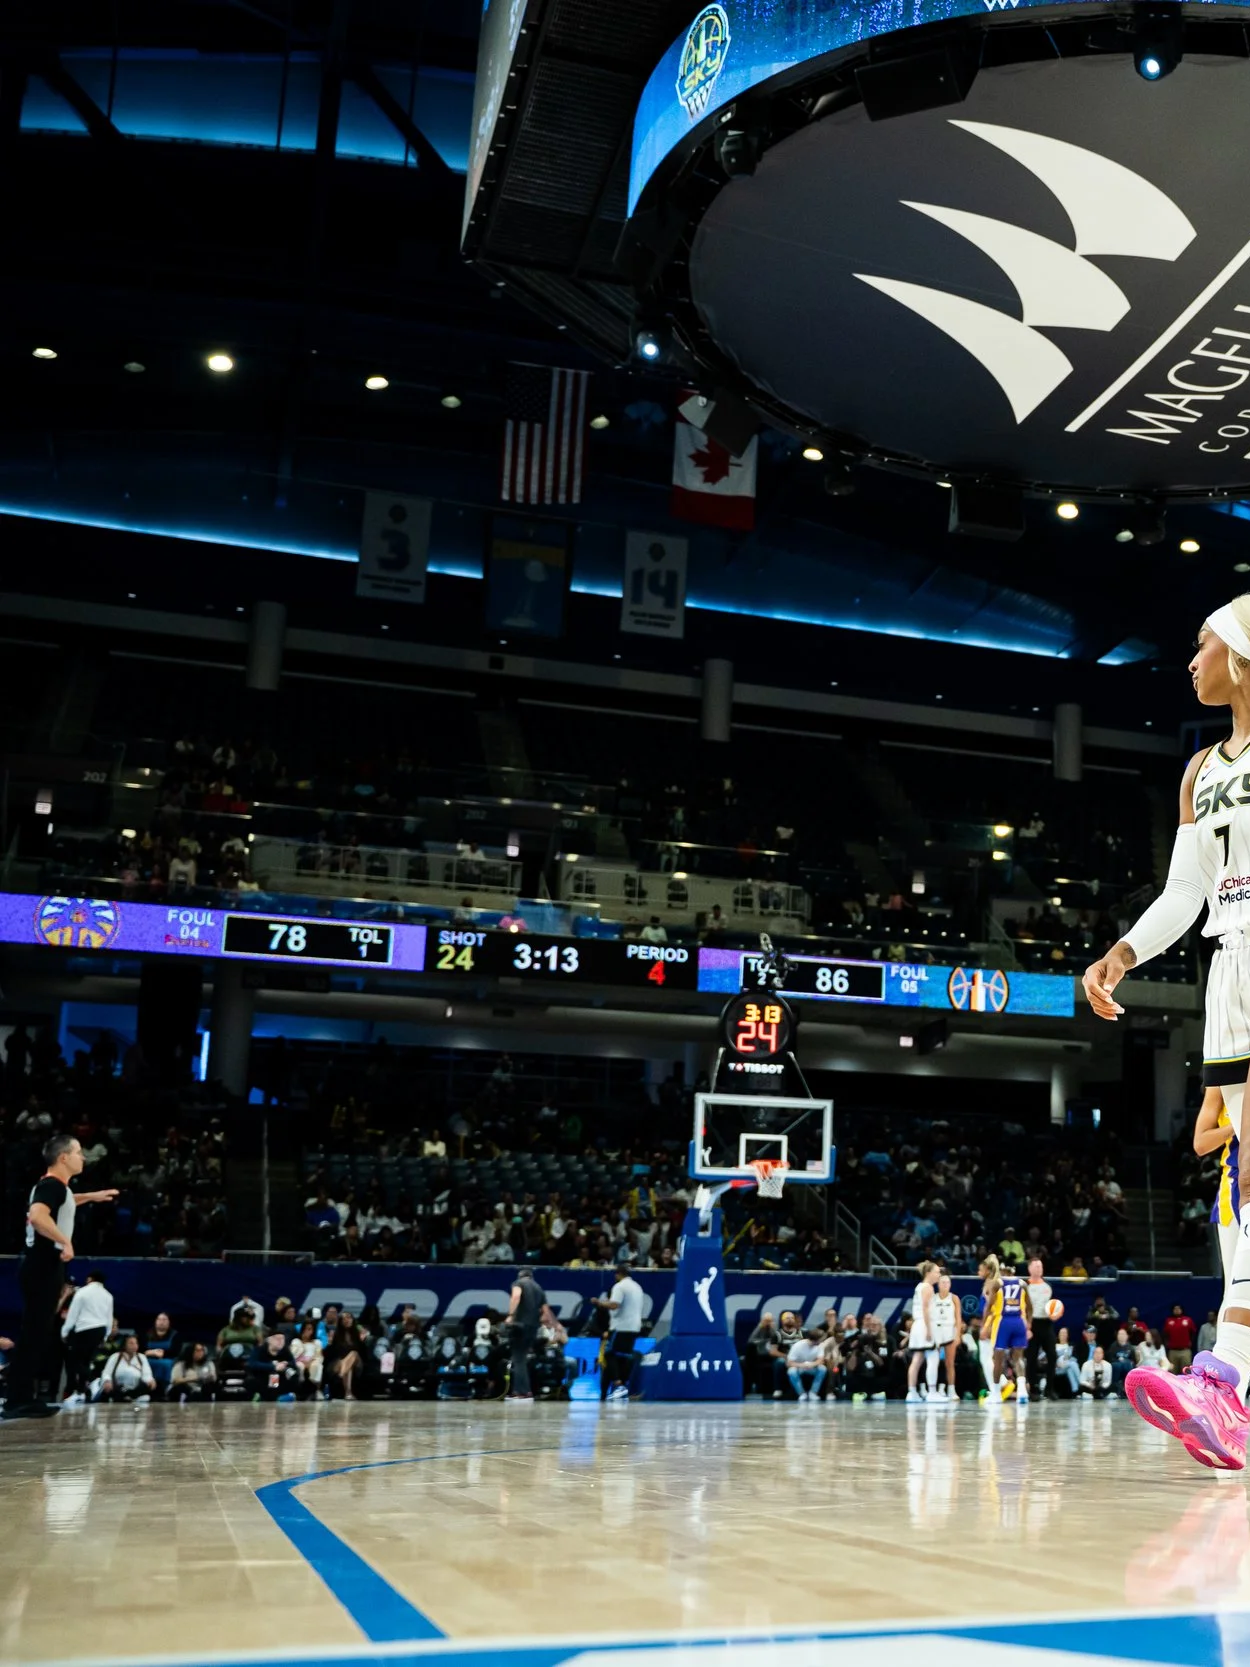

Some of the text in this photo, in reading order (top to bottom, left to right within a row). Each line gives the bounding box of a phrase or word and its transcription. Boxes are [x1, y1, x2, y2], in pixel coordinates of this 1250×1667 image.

[378, 529, 410, 570] 3
[630, 567, 678, 609] 14
[167, 909, 215, 926] FOUL
[180, 924, 199, 940] 04
[268, 923, 307, 952] 78
[349, 928, 383, 944] TOL
[438, 930, 487, 947] SHOT
[357, 944, 368, 958] 1
[436, 945, 475, 971] 24
[513, 943, 580, 974] 3:13
[626, 944, 689, 963] PERIOD
[647, 960, 666, 986] 4
[757, 972, 767, 985] 2
[815, 967, 849, 993] 86
[891, 965, 928, 980] FOUL
[901, 981, 918, 993] 05
[745, 1003, 781, 1023] 3:13
[736, 1020, 777, 1053] 24
[743, 1063, 784, 1074] TISSOT
[1004, 1284, 1020, 1299] 17
[666, 1360, 733, 1372] THRTY
